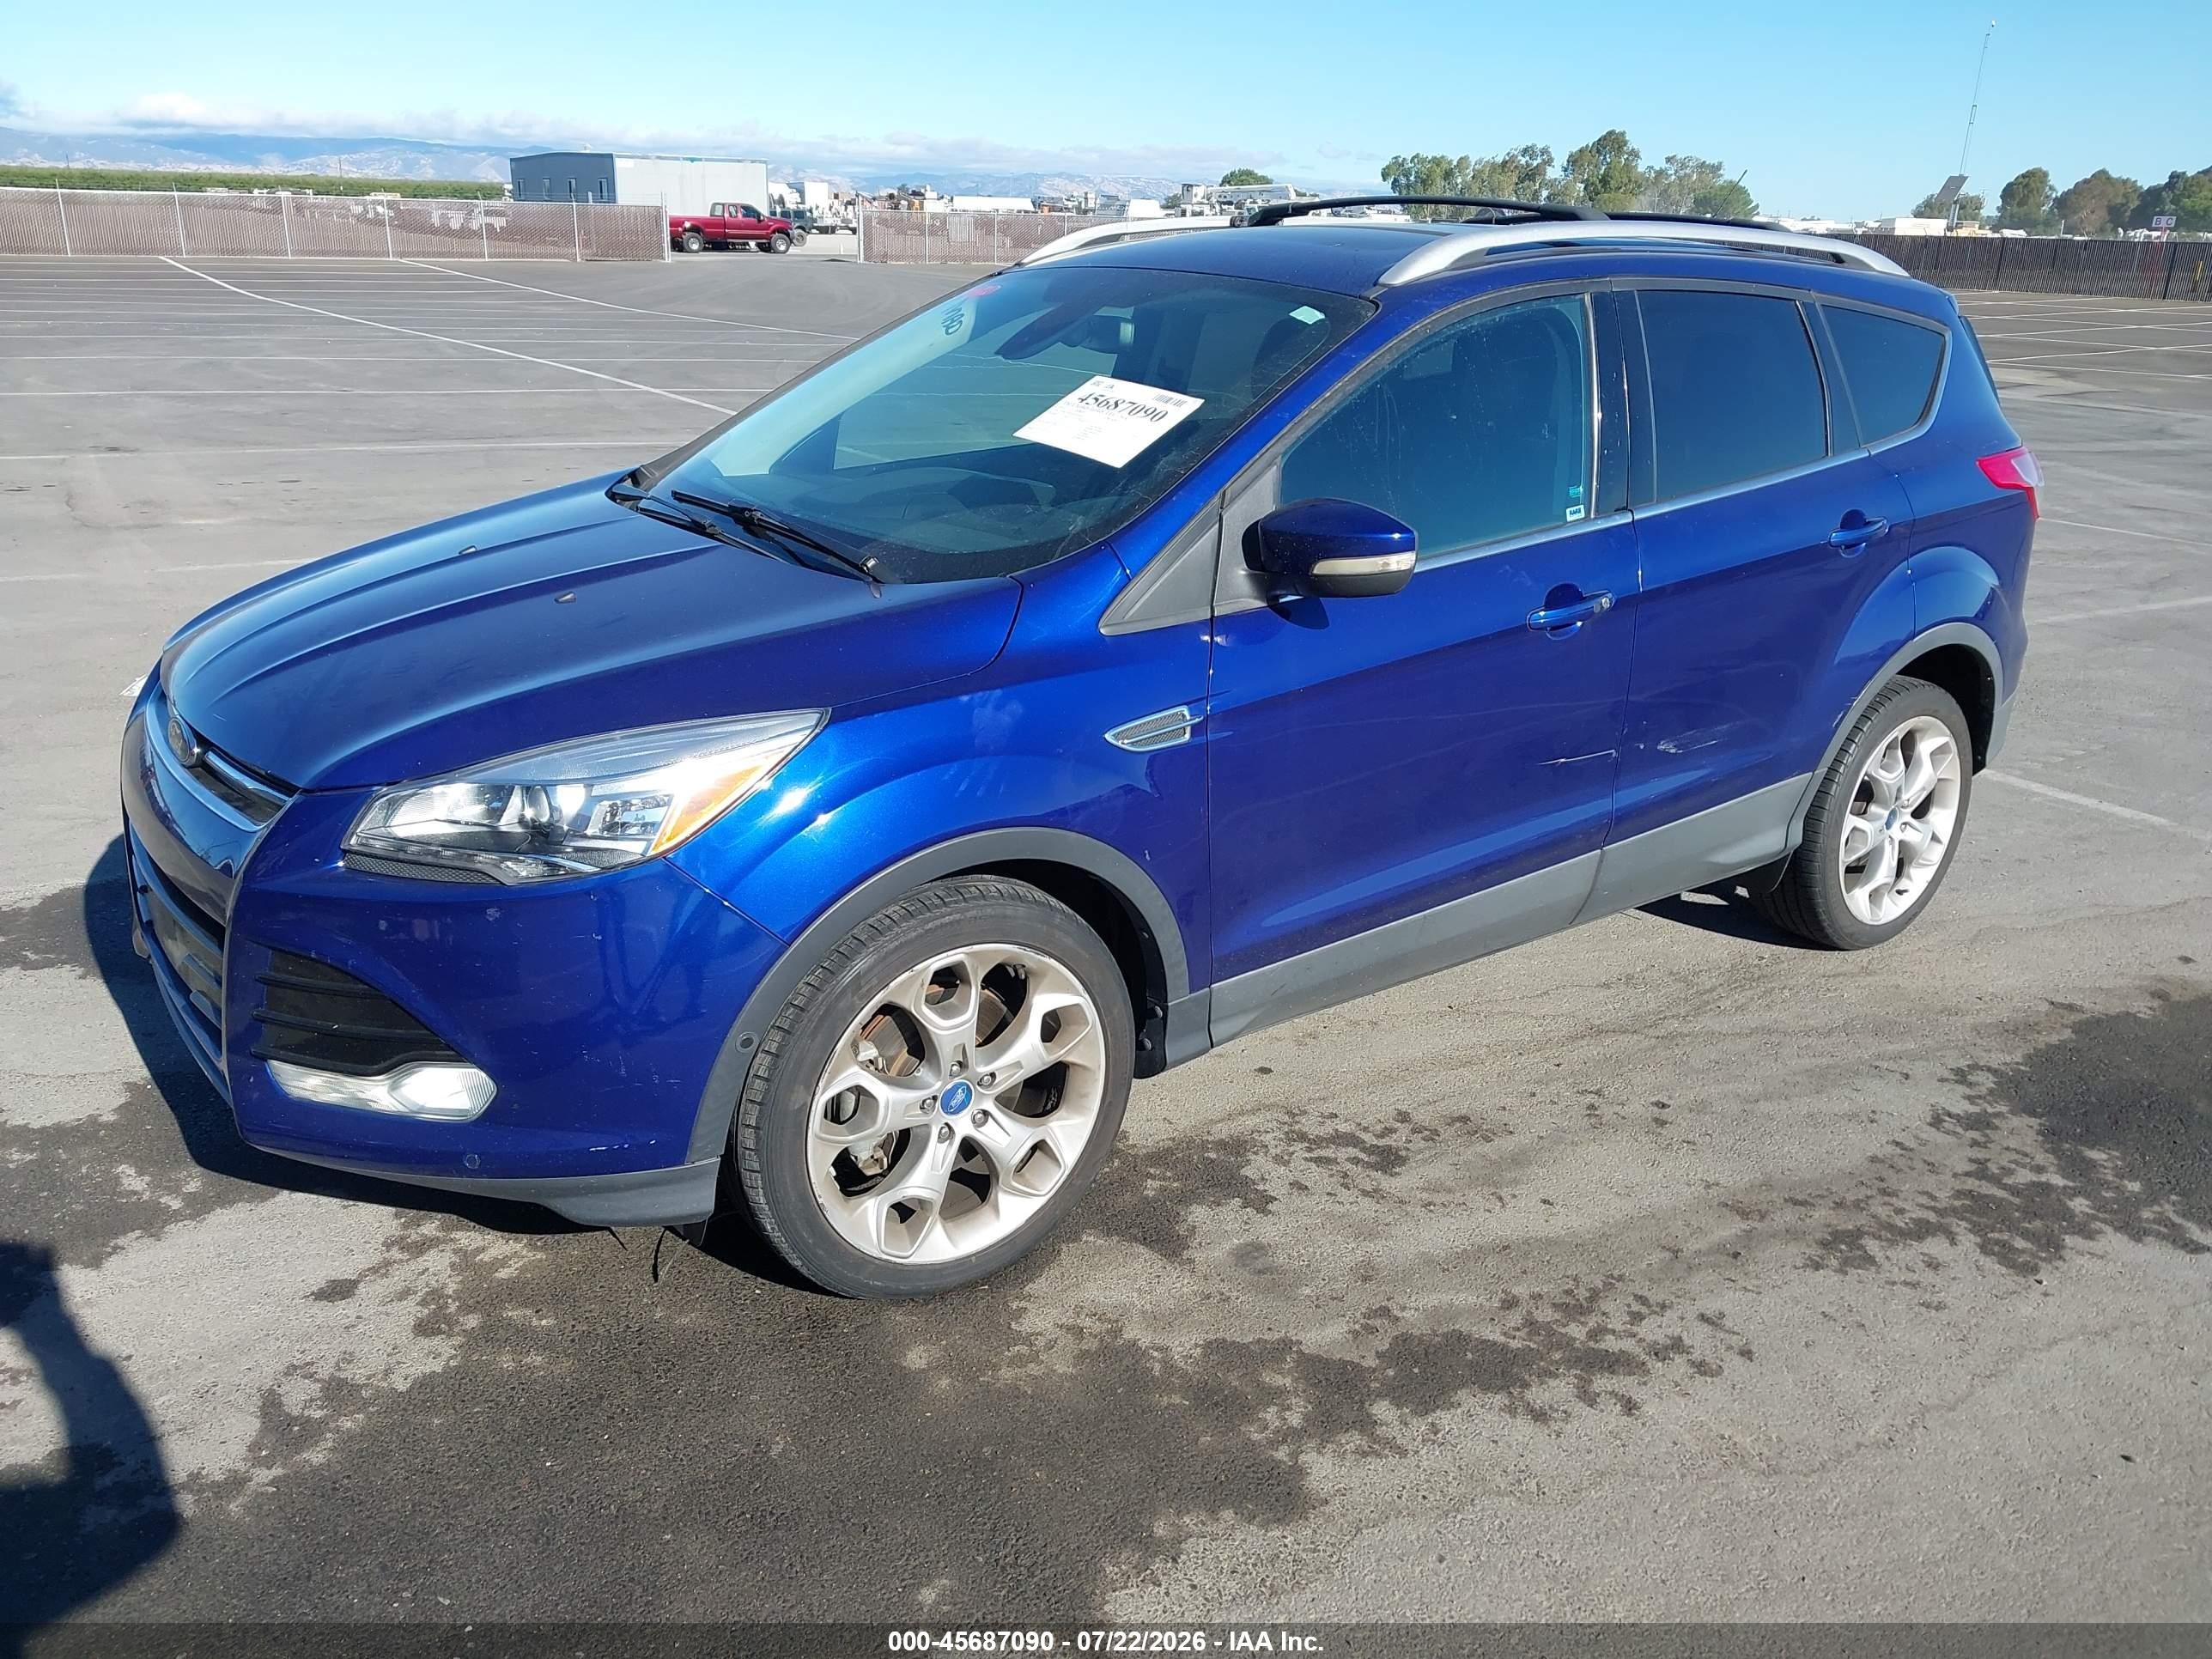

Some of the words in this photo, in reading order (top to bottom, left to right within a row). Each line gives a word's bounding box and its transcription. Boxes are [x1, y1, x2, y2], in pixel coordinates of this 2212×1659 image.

[2154, 217, 2161, 226] B
[2166, 217, 2173, 226] C
[1078, 392, 1169, 422] 45687090
